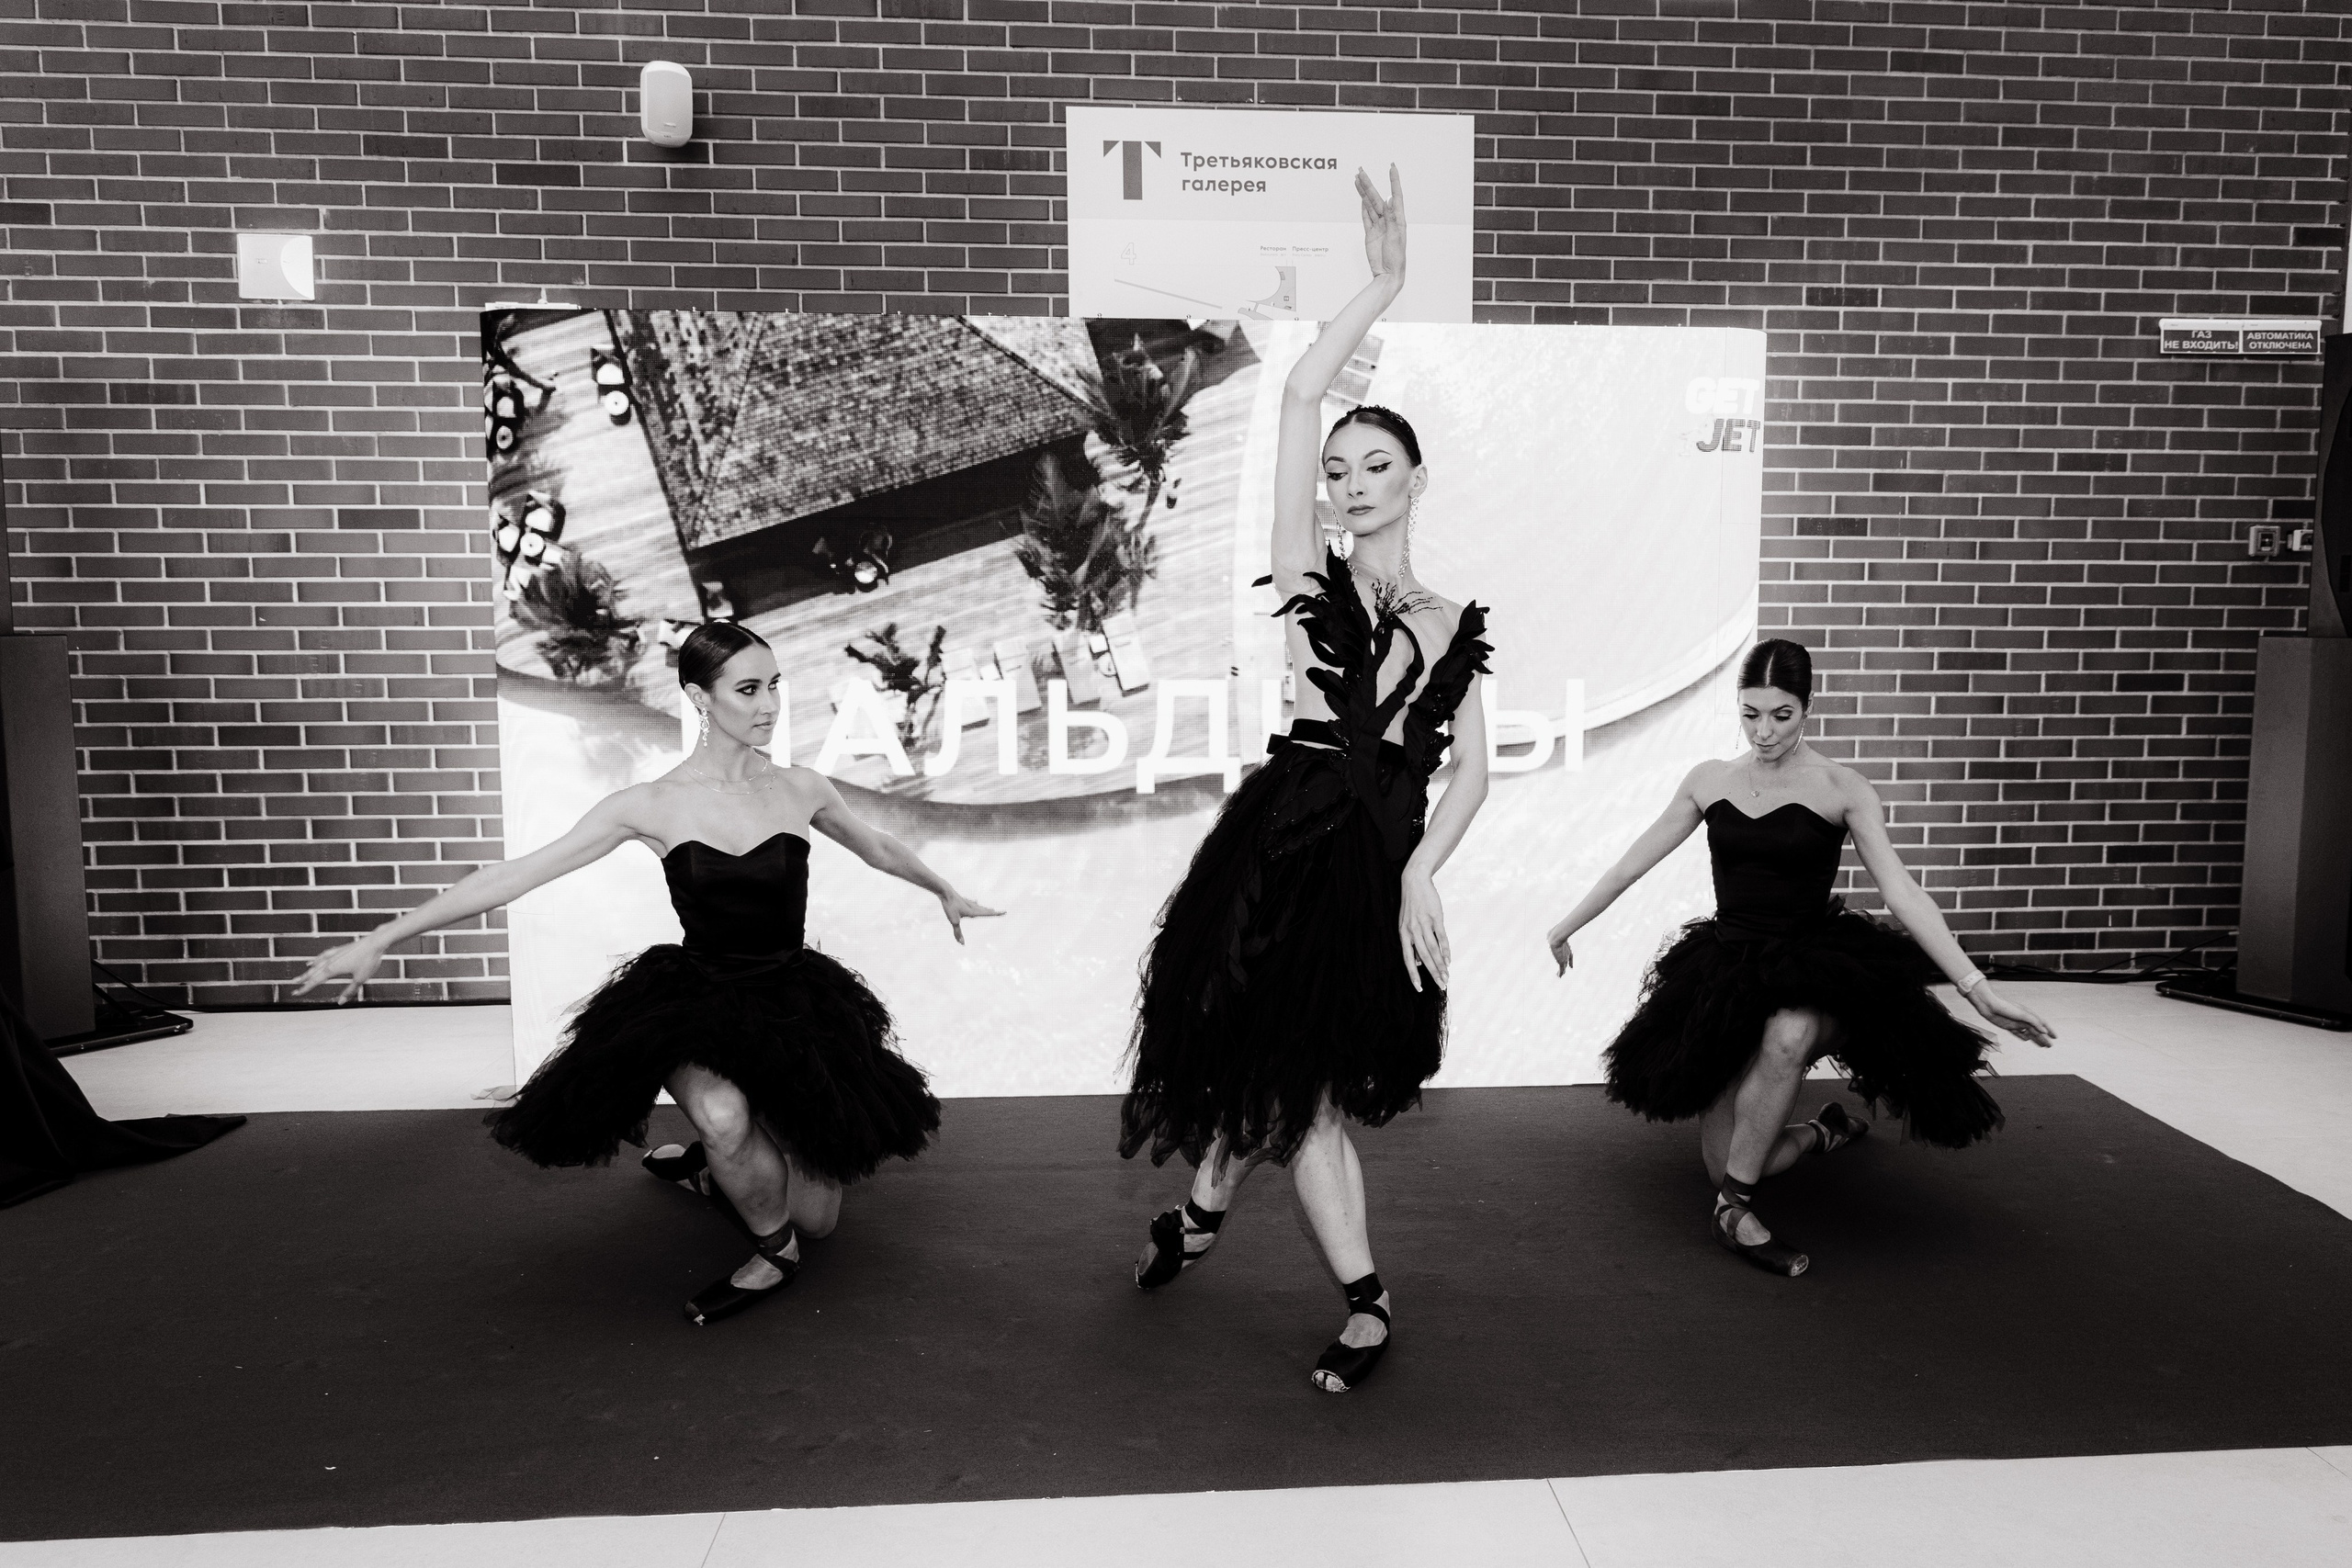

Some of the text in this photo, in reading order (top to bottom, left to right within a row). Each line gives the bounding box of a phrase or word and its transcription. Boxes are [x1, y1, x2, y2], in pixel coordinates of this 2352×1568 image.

[1181, 152, 1338, 172] Третьяковская
[1182, 178, 1267, 197] галерея
[1120, 242, 1137, 265] 4
[1292, 245, 1329, 254] Пресс-центр
[2191, 331, 2212, 339] ГАЗ
[2246, 332, 2314, 341] АВТОМАТИКА
[2164, 340, 2239, 351] НЕ ВХОДИТЬ!
[2248, 341, 2312, 350] ОТКЛЮЧЕНА
[1685, 376, 1760, 414] GET
[1696, 418, 1761, 453] JET
[682, 678, 1585, 794] АЛЬДЫ
